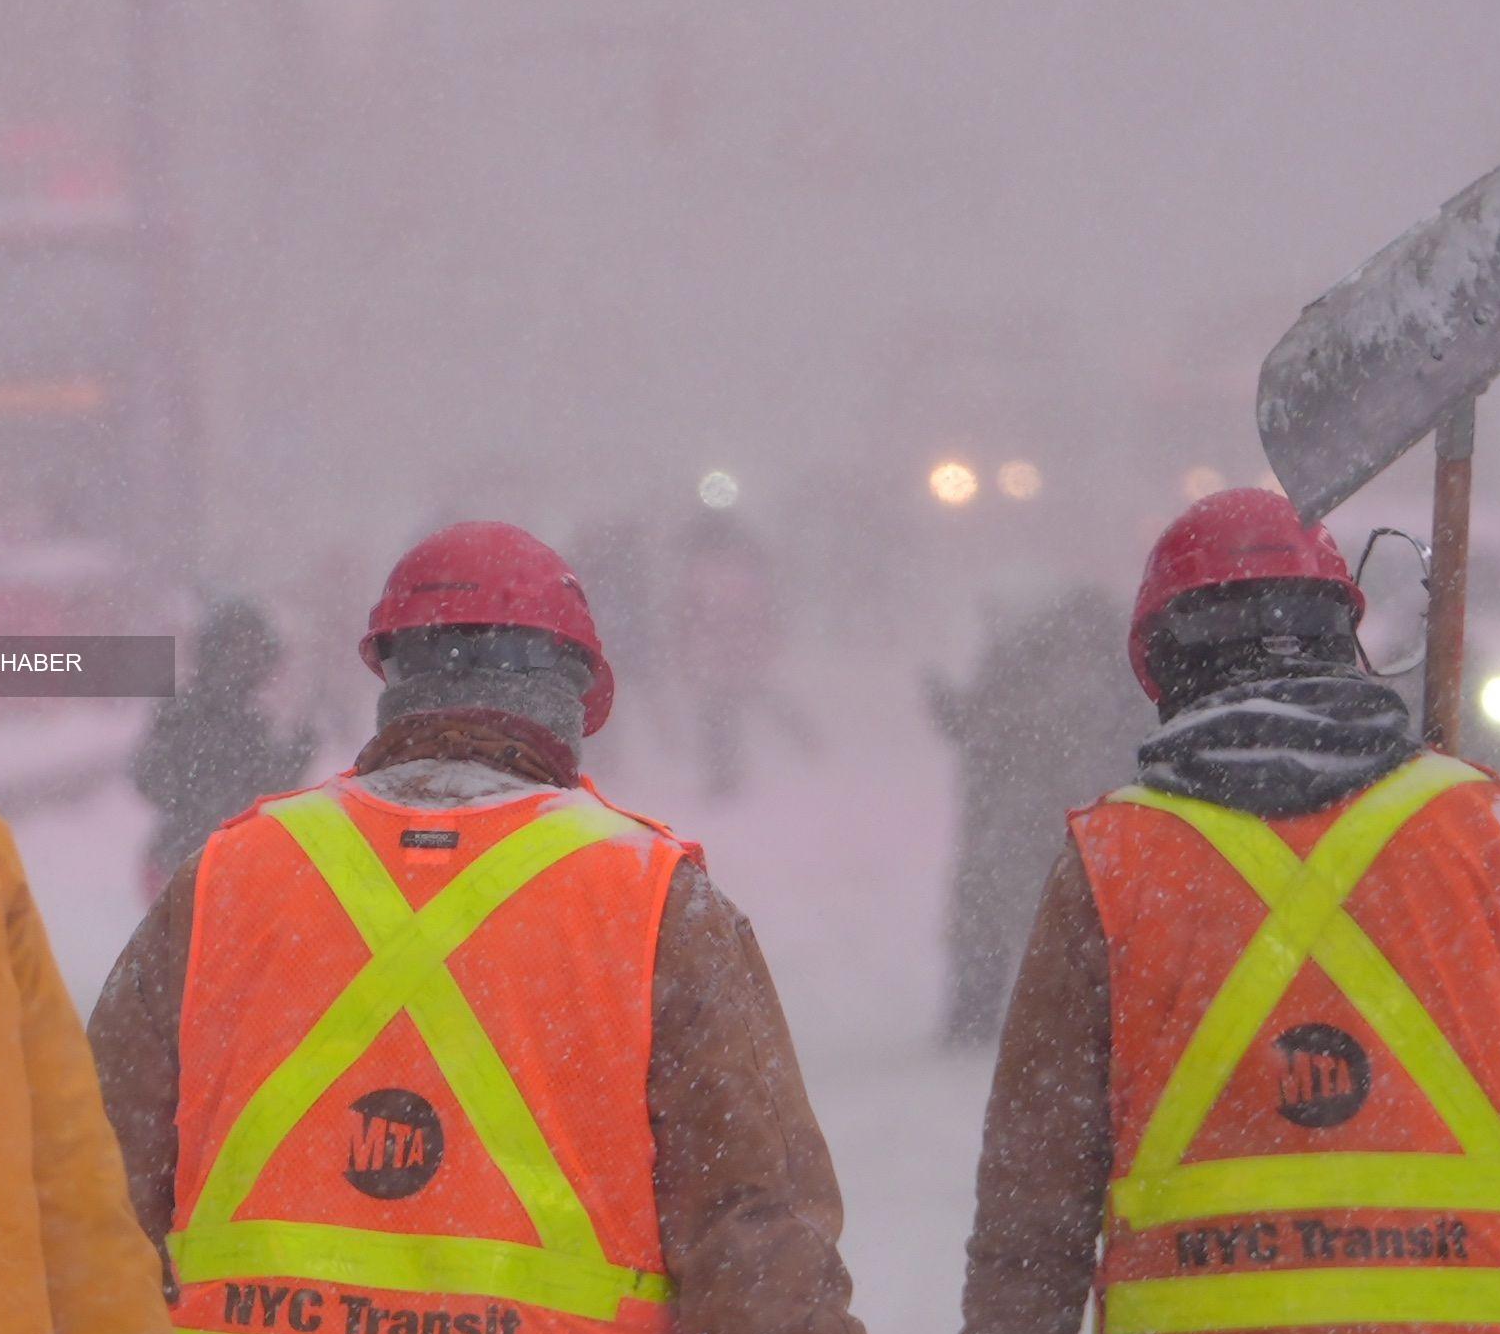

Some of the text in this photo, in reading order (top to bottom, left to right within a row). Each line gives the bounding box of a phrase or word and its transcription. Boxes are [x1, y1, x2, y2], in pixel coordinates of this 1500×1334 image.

[1280, 1046, 1353, 1105] MTA
[344, 1117, 426, 1172] MTA
[1176, 1217, 1469, 1267] NYC Transit
[223, 1282, 324, 1333] NYC
